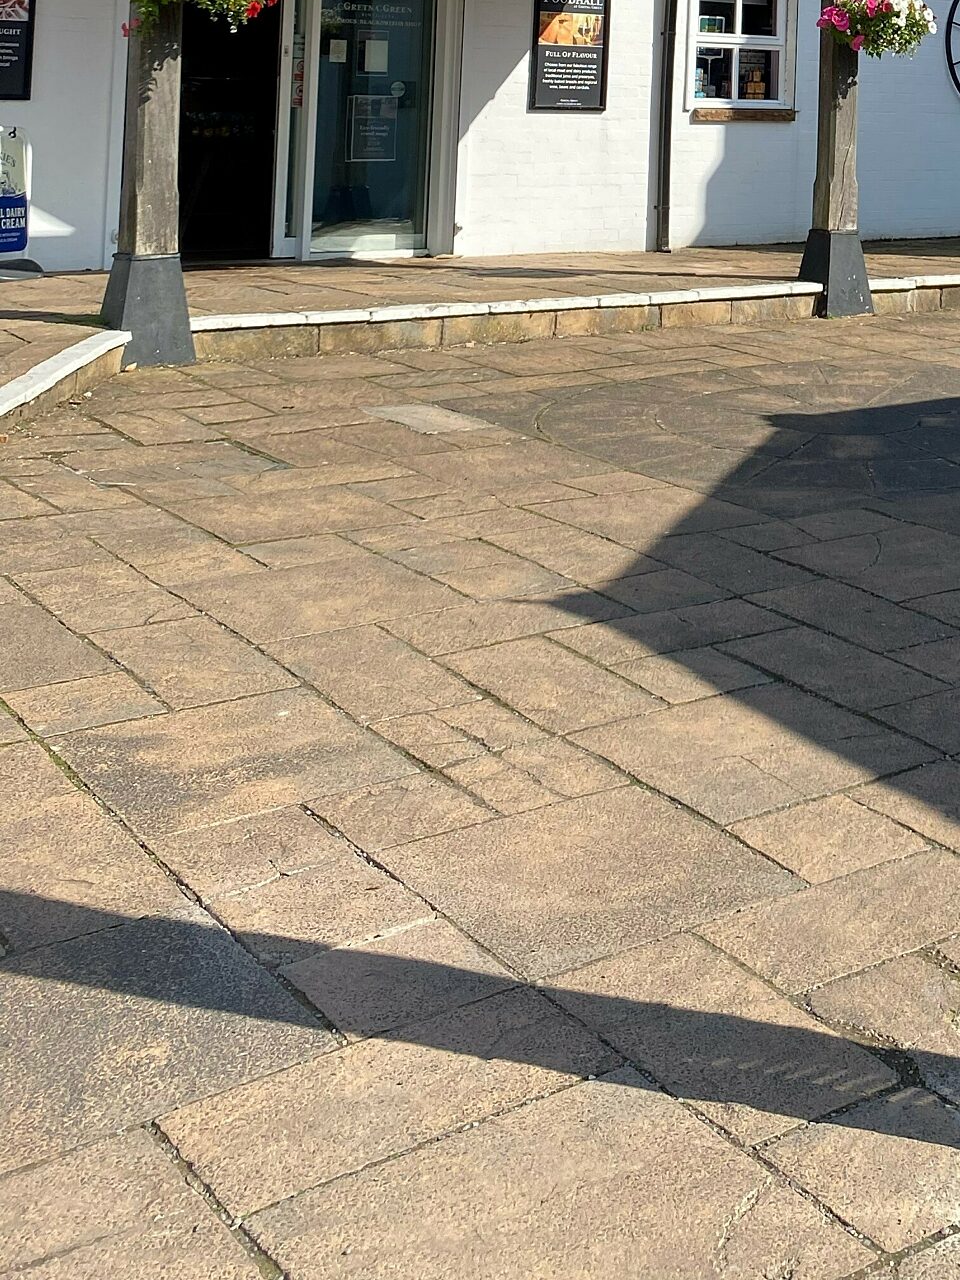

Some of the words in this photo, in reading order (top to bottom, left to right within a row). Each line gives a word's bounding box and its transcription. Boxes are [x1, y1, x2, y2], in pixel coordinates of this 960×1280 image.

[545, 50, 561, 58] FULL
[571, 51, 598, 59] FLAVOUR
[6, 207, 26, 217] DAIRY
[1, 218, 26, 229] CREAM
